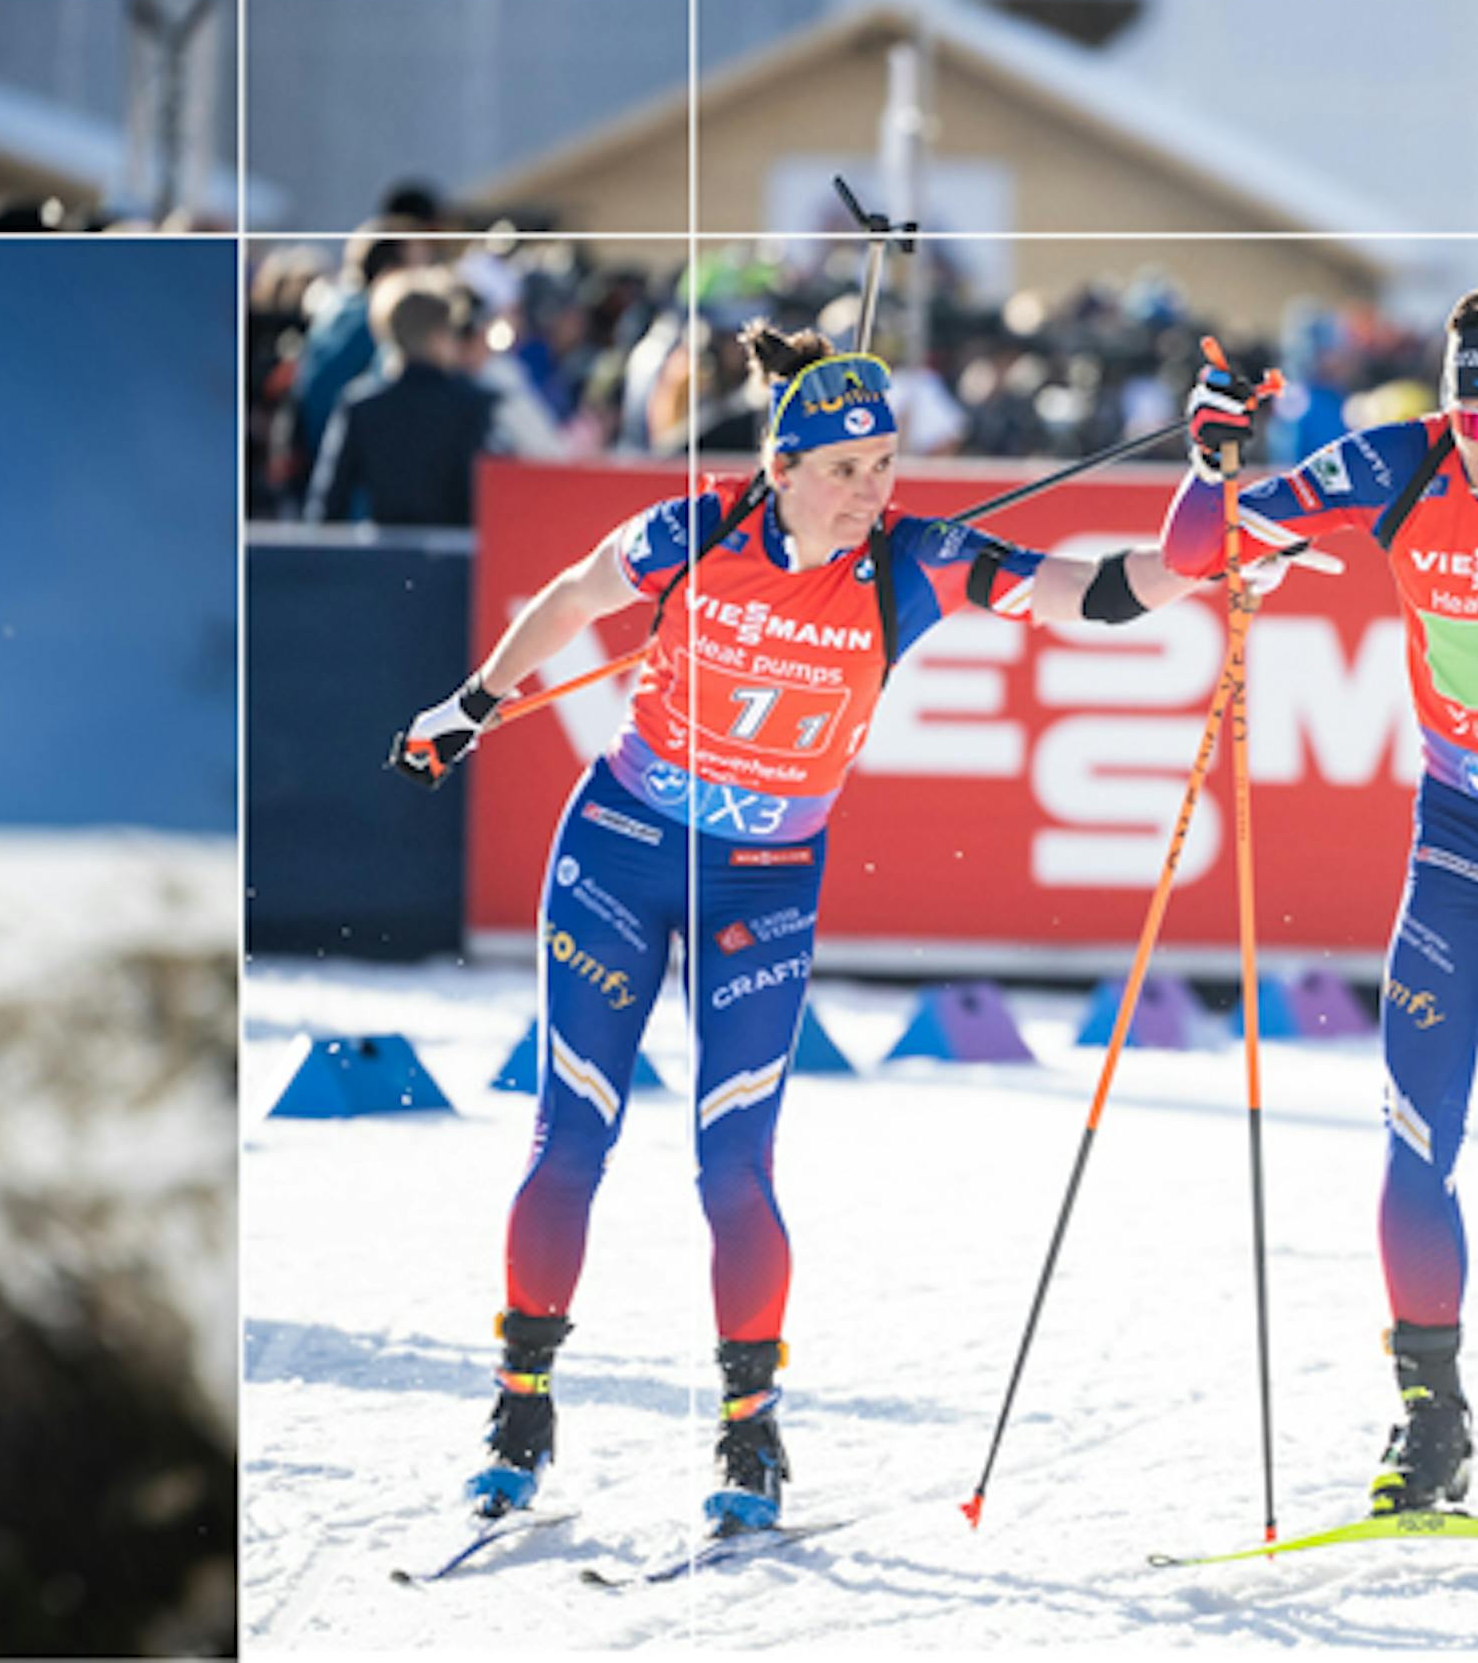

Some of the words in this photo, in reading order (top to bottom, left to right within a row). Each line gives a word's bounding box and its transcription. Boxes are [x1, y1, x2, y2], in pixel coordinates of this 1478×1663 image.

[684, 585, 873, 651] VIESSMANN
[691, 632, 748, 670] Heat
[750, 652, 844, 686] pumps
[728, 684, 783, 741] 1
[794, 711, 830, 750] 1
[706, 784, 789, 835] X3
[711, 954, 804, 1010] CRAFT
[1385, 977, 1445, 1030] mfy
